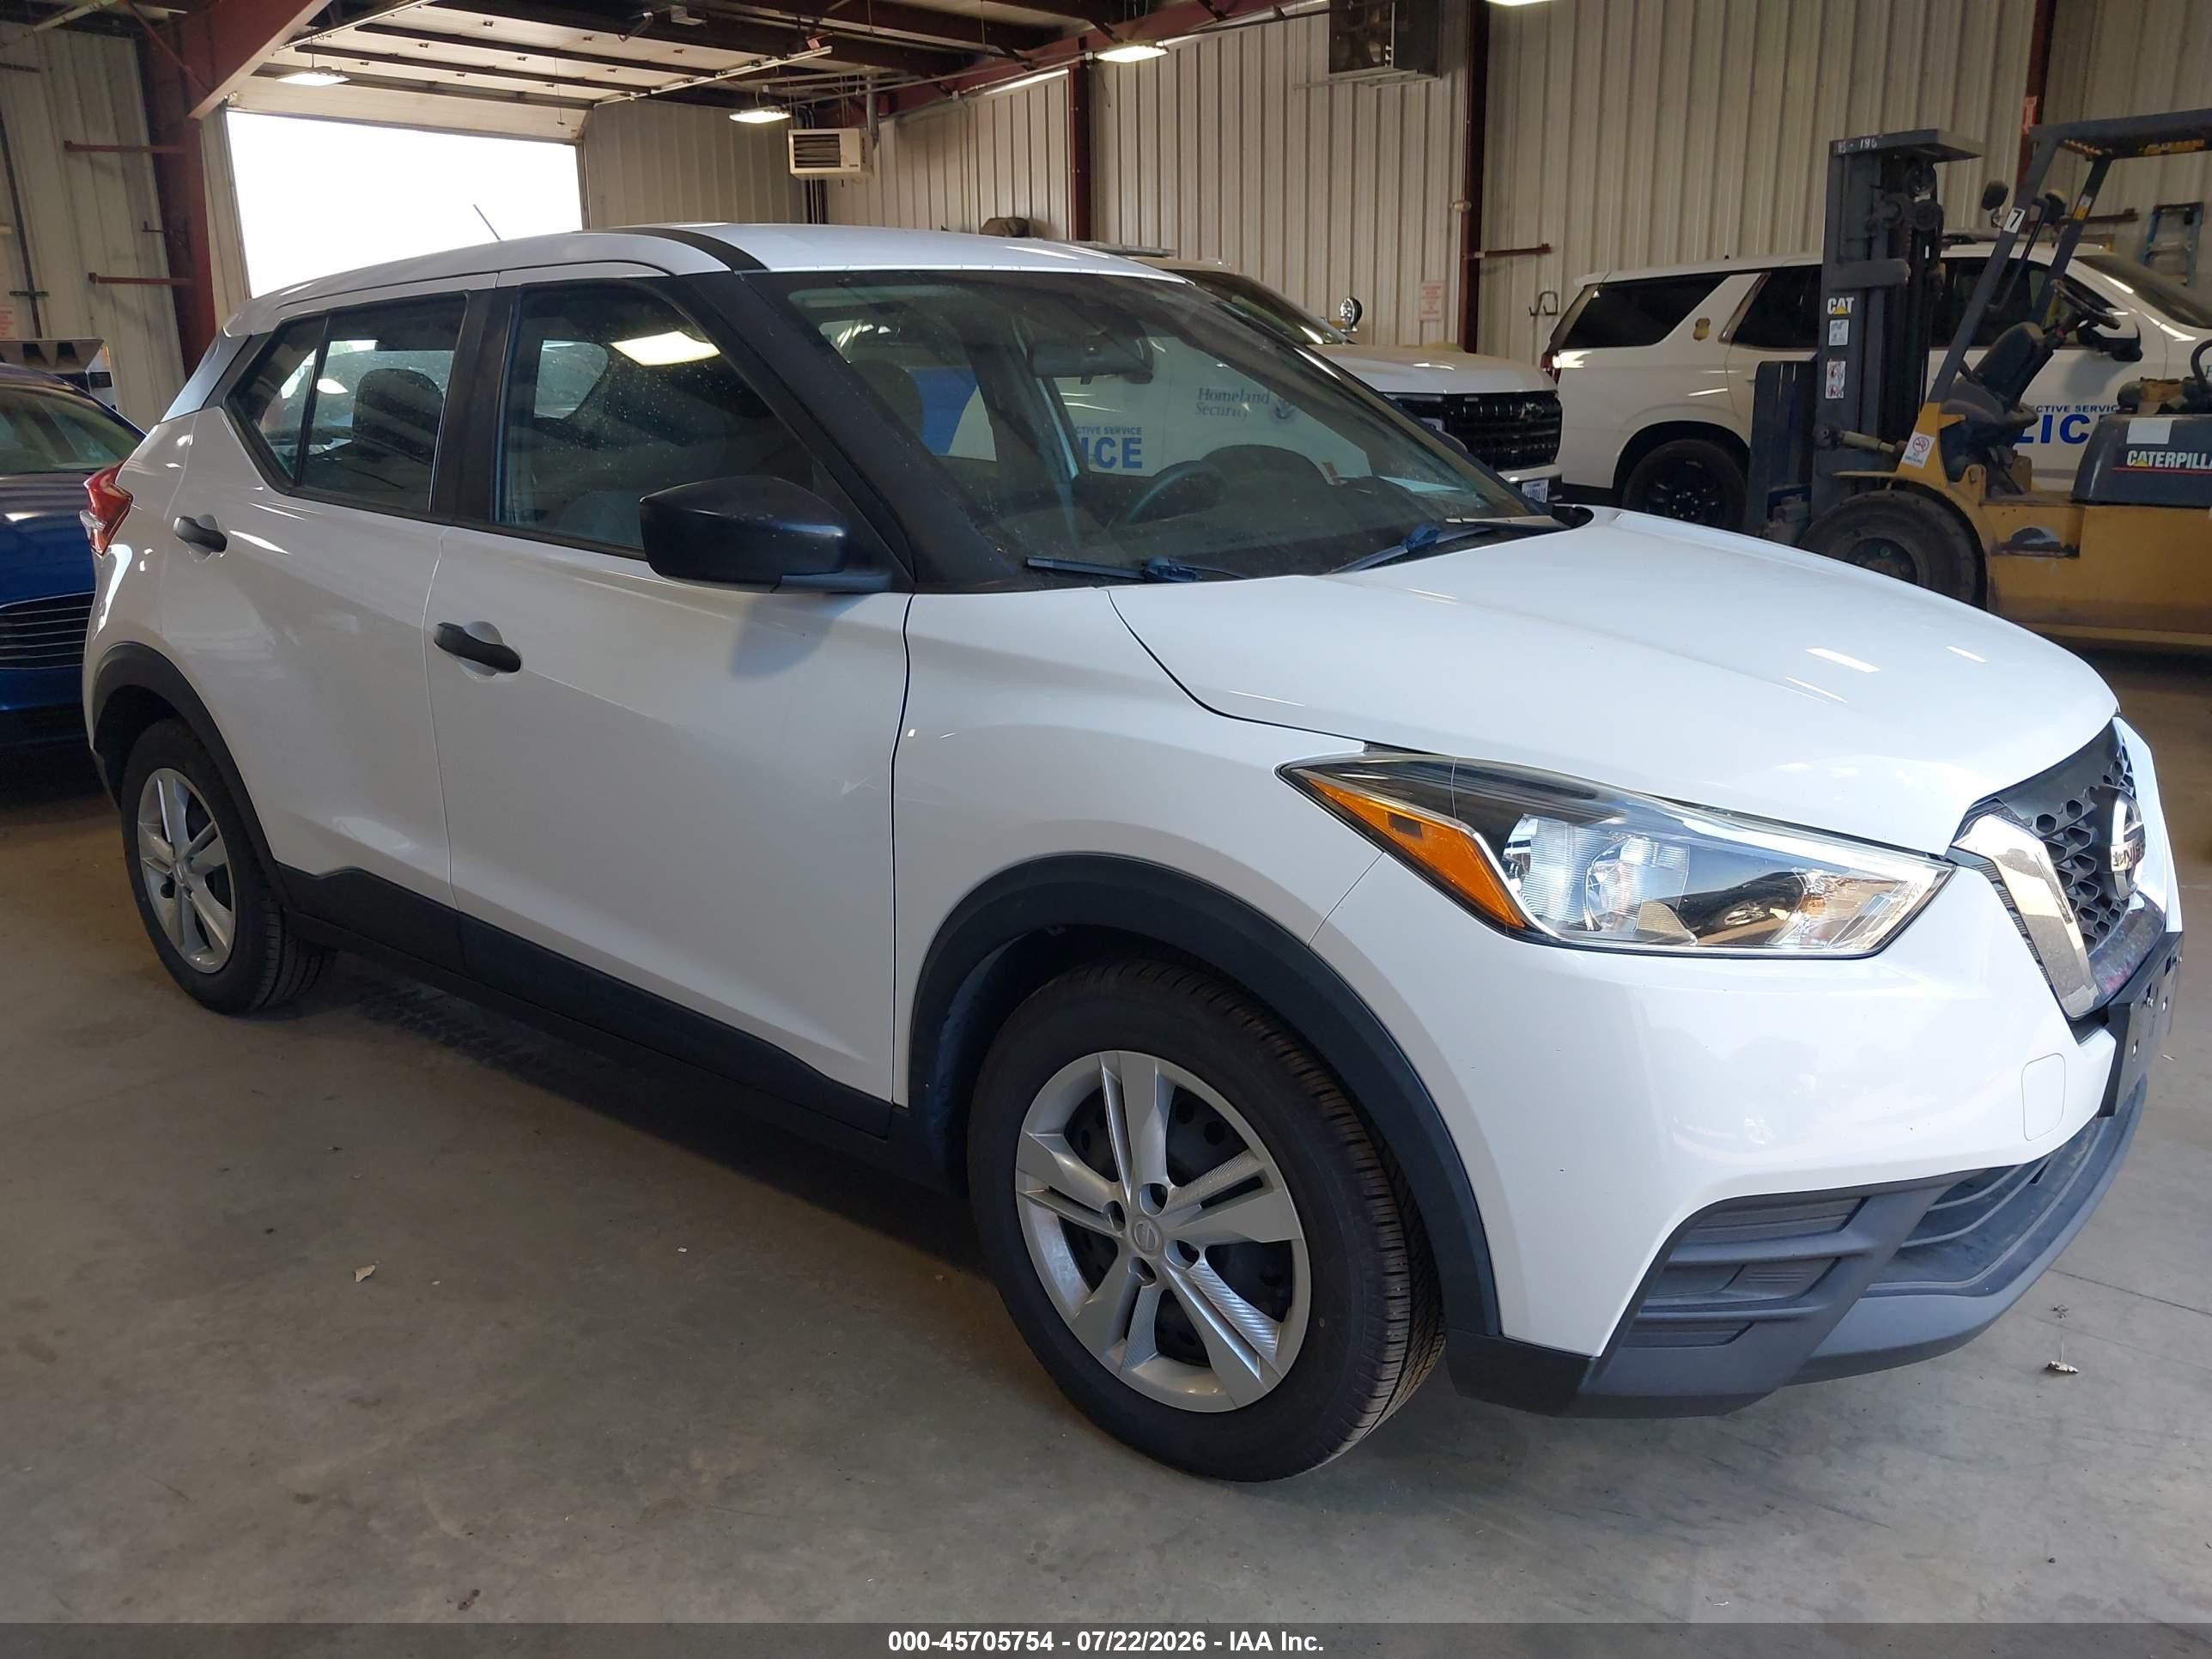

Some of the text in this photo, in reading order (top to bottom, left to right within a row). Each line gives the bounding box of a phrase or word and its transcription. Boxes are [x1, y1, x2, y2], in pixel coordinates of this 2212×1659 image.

[2009, 210, 2023, 228] 7
[1826, 297, 1855, 314] CAT
[1197, 387, 1271, 404] Homeland
[2033, 404, 2070, 413] CTIVE
[1104, 426, 1142, 435] SERVICE
